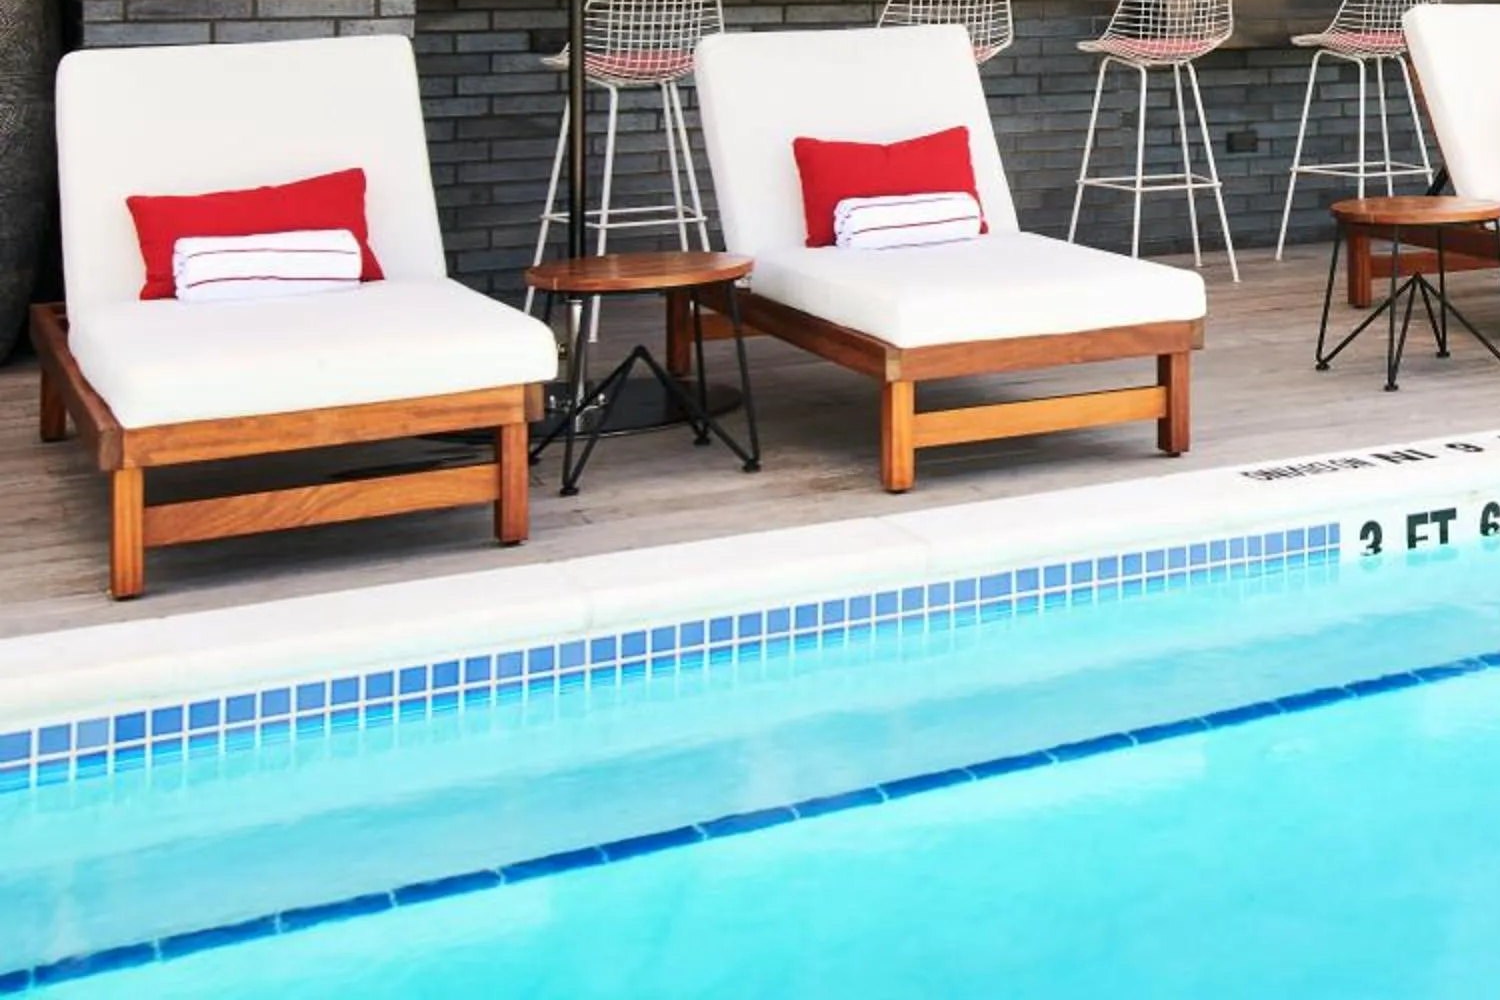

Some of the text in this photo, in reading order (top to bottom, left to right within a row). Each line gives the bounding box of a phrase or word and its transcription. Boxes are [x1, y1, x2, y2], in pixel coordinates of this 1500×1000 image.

[1372, 448, 1438, 465] IN
[1445, 442, 1484, 454] 6
[1359, 520, 1383, 556] 3
[1406, 507, 1457, 550] FT
